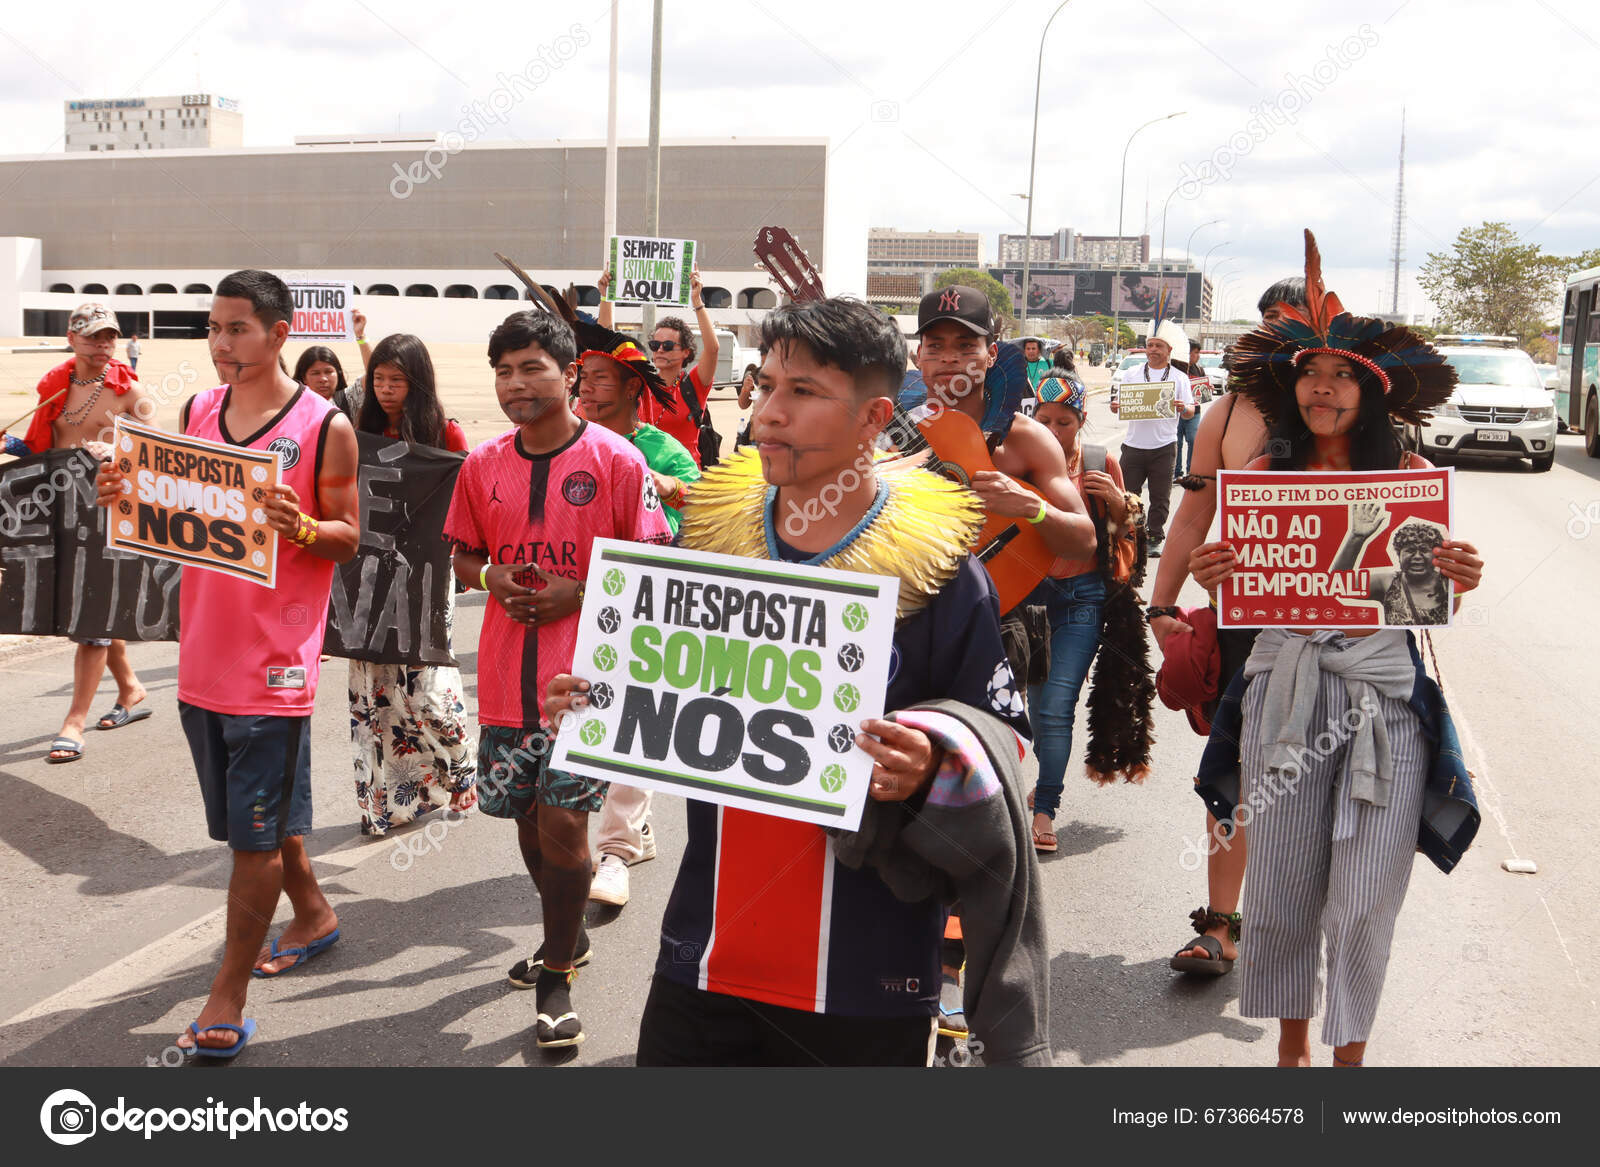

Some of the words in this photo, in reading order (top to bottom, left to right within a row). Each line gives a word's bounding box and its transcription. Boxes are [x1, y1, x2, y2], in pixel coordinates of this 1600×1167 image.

[623, 240, 676, 260] SEMPRE
[623, 259, 675, 281] ESTIVEMOS
[290, 289, 345, 309] UTURO
[622, 280, 673, 301] AQUI
[138, 442, 150, 468] A
[154, 445, 246, 489] RESPOSTA
[137, 469, 247, 522] SOMOS
[1230, 489, 1273, 502] PELO
[1277, 489, 1311, 502] FIM
[1315, 488, 1339, 501] DO
[1343, 483, 1439, 501] GENOCÍDIO
[138, 503, 246, 561] NÓS
[1227, 509, 1278, 539] NÃO
[1286, 514, 1321, 539] AO
[1230, 543, 1317, 568] MARCO
[1230, 570, 1368, 597] TEMPORAL!
[632, 575, 654, 621] A
[663, 578, 827, 648] RESPOSTA
[629, 624, 822, 711] SOMOS
[613, 685, 815, 786] NÓS
